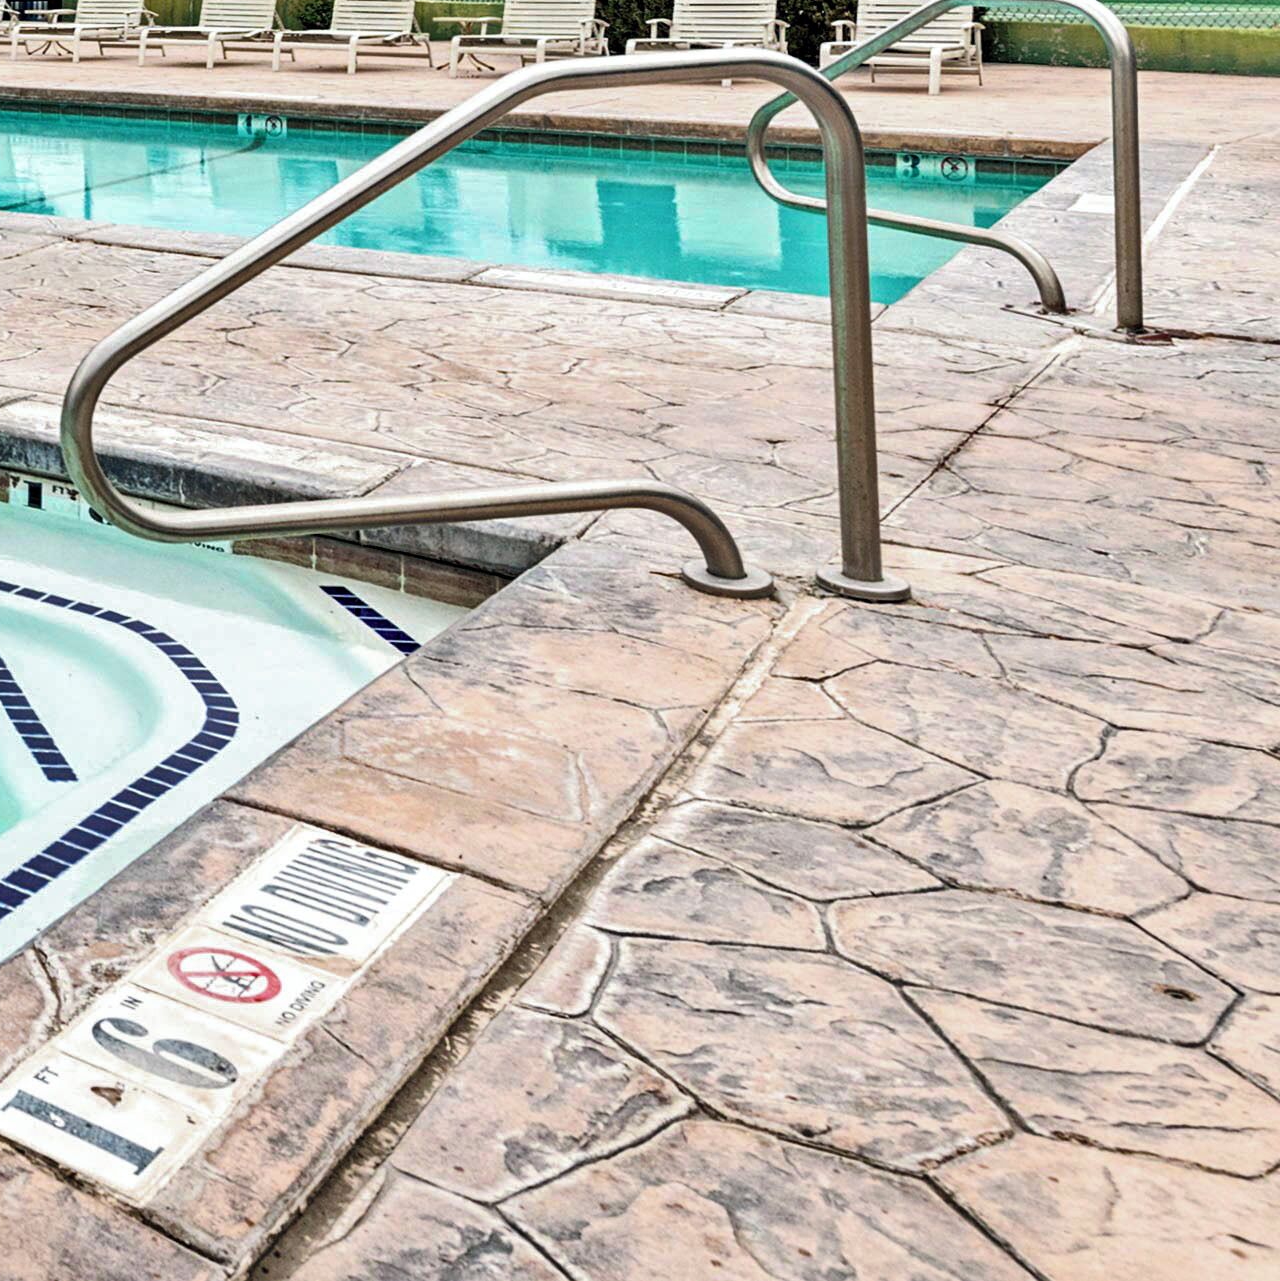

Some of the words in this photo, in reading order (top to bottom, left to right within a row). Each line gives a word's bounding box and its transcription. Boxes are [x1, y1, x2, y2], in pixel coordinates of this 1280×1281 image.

[259, 838, 420, 927] DIVING
[222, 904, 349, 955] NO
[120, 995, 143, 1010] IN
[275, 1011, 297, 1026] NO
[289, 980, 326, 1012] DIVING
[33, 1065, 59, 1085] FT
[91, 1017, 239, 1090] 6
[0, 1088, 164, 1176] 1
